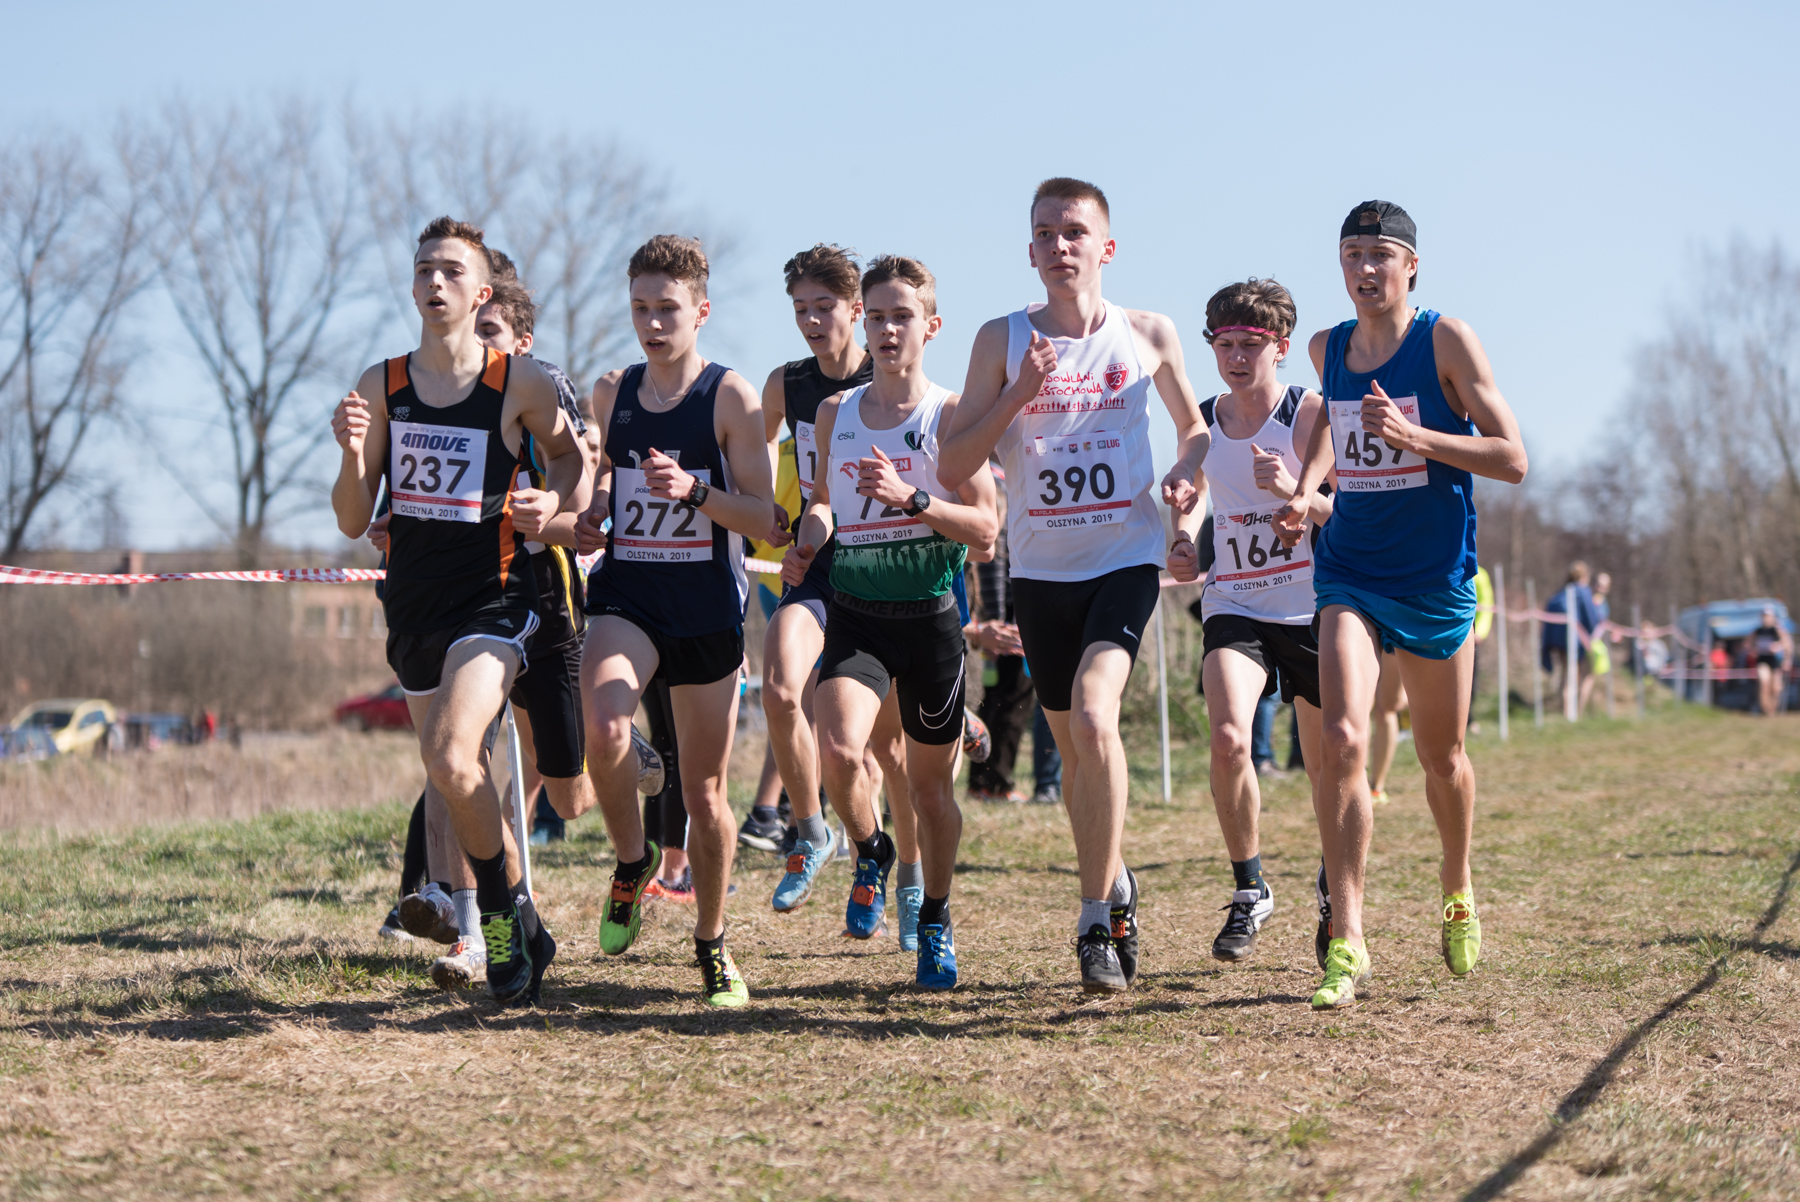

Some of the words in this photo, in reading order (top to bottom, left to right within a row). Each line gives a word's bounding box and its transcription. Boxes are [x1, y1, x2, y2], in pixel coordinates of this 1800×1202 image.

[1046, 371, 1093, 383] DOWLANi
[1038, 382, 1104, 396] STOCHOWA
[401, 432, 470, 453] 4MOVE
[1106, 439, 1120, 449] LUG
[399, 453, 470, 495] 237
[635, 486, 650, 494] pola
[1038, 462, 1115, 506] 390
[1348, 480, 1382, 490] OLSZYNA
[1386, 478, 1407, 488] 2019
[401, 504, 434, 516] OLSZYNA
[438, 508, 459, 518] 2019
[624, 500, 697, 538] 272
[1046, 517, 1087, 528] OLSZYNA
[1091, 513, 1113, 524] 2019
[852, 532, 888, 543] OLSZYNA
[892, 529, 913, 539] 2019
[626, 550, 665, 560] OLSZYNA
[670, 551, 692, 560] 2019
[1226, 534, 1293, 570] 164
[1233, 580, 1269, 591] OLSZYNA
[1272, 574, 1293, 586] 2019
[891, 601, 931, 616] PRO
